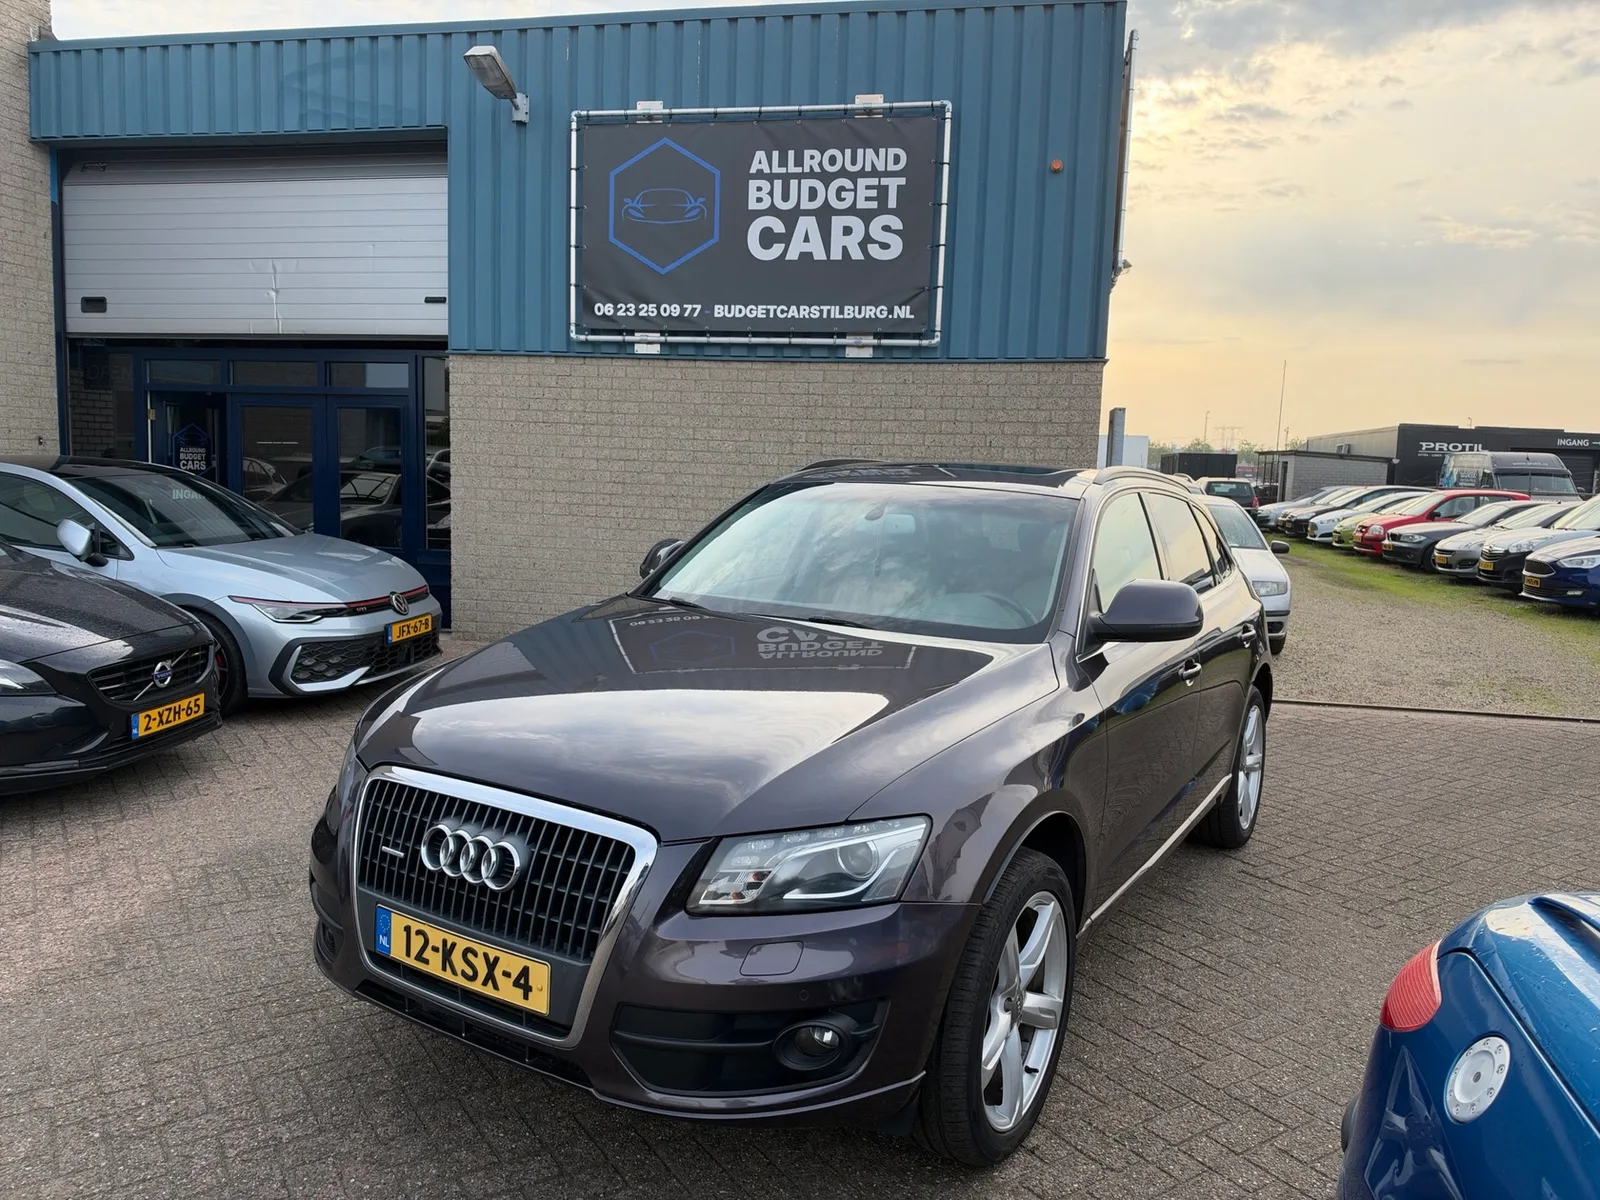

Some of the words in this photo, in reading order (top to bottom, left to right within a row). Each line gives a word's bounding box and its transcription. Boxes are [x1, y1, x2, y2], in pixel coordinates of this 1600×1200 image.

[749, 147, 908, 174] ALLROUND
[748, 177, 907, 211] BUDGET
[747, 214, 904, 262] CARS
[594, 303, 614, 316] 06
[617, 303, 636, 317] 23
[638, 303, 657, 317] 25
[660, 304, 680, 317] 09
[683, 304, 702, 317] 77
[714, 304, 915, 320] BUDGETCARSTILBURG.NL
[1419, 442, 1488, 452] PROTIL
[1557, 438, 1590, 447] INGANG
[180, 460, 207, 470] CARS
[397, 618, 430, 639] JFX-67-B
[144, 698, 201, 732] 2-XZH-65
[379, 934, 390, 948] NL
[403, 924, 533, 1001] 12-KSX-4
